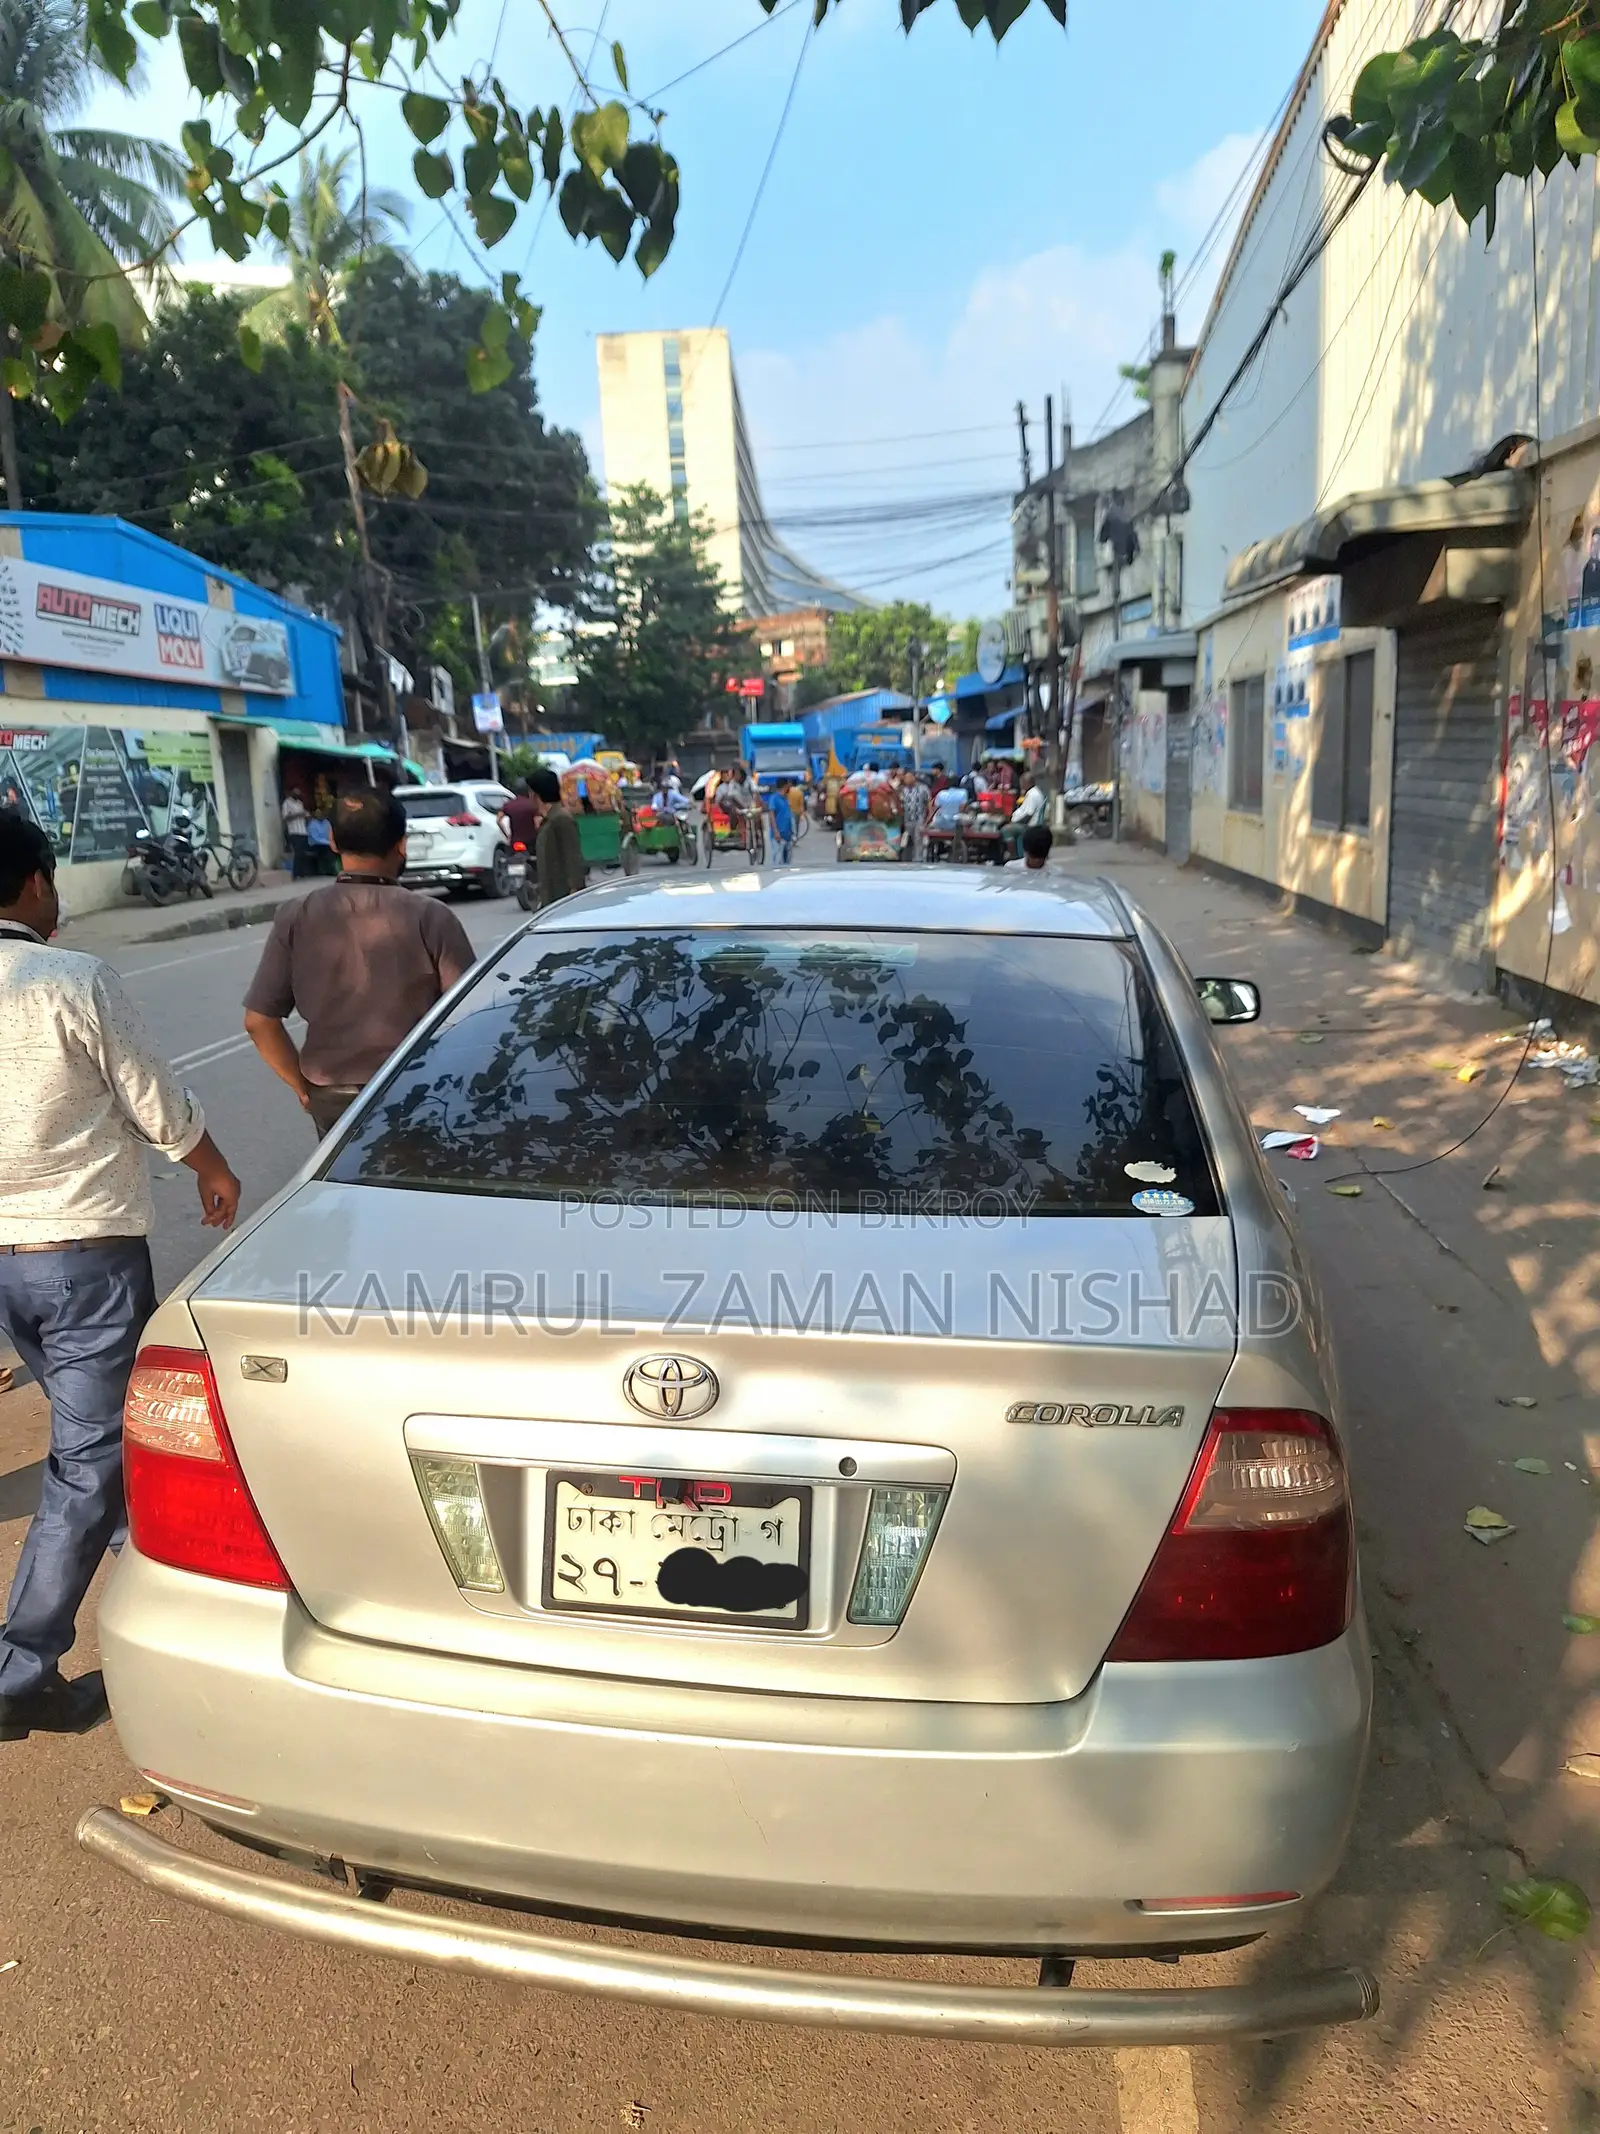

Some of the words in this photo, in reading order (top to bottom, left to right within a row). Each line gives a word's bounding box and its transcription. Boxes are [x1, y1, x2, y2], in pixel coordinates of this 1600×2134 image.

[158, 634, 203, 669] MOLY
[1005, 1401, 1185, 1428] COROLLA
[566, 1505, 636, 1536] ঢাকা
[760, 1518, 785, 1547] গ
